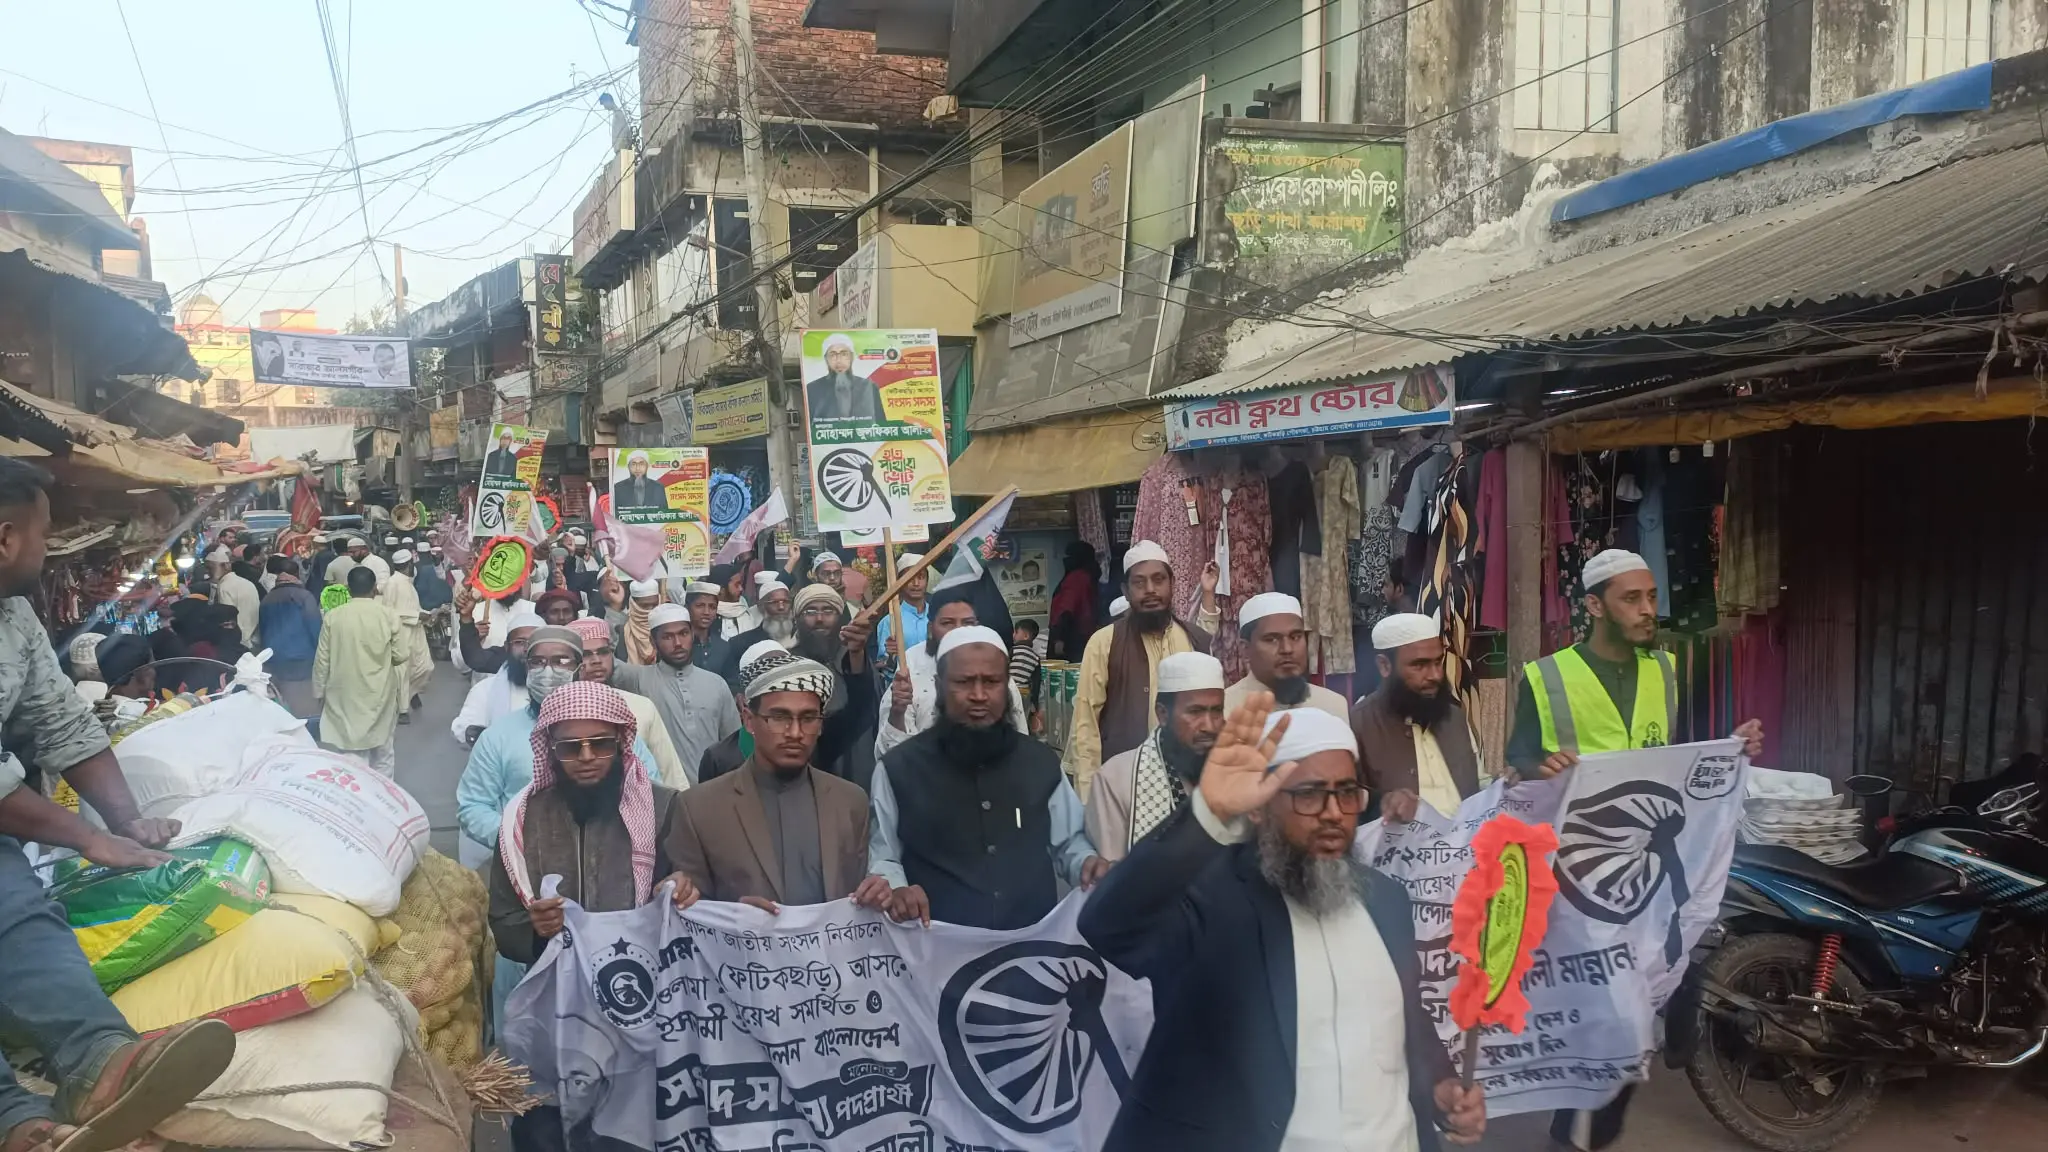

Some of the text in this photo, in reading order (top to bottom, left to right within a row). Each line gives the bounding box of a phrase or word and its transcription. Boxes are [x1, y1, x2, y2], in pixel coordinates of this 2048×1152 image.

[1301, 168, 1367, 208] কোম্পানী
[887, 396, 936, 409] সংসদ সদস্য
[1194, 381, 1396, 429] নবী ক্লথ ষ্টোর
[815, 427, 854, 441] মোহাম্মদ
[855, 423, 899, 440] জুলফিকার
[878, 457, 916, 471] পাখায়
[883, 468, 915, 484] ভোট
[888, 482, 911, 499] দিন
[722, 930, 772, 952] জাতীয়
[778, 931, 822, 953] সংসদ
[825, 919, 884, 946] নির্বাচনে
[717, 960, 842, 994] (ফটিকছড়ি)
[789, 993, 860, 1025] সমর্থিত
[814, 1022, 901, 1057] বাংলাদেশ
[835, 1082, 915, 1122] পদপ্রার্থী
